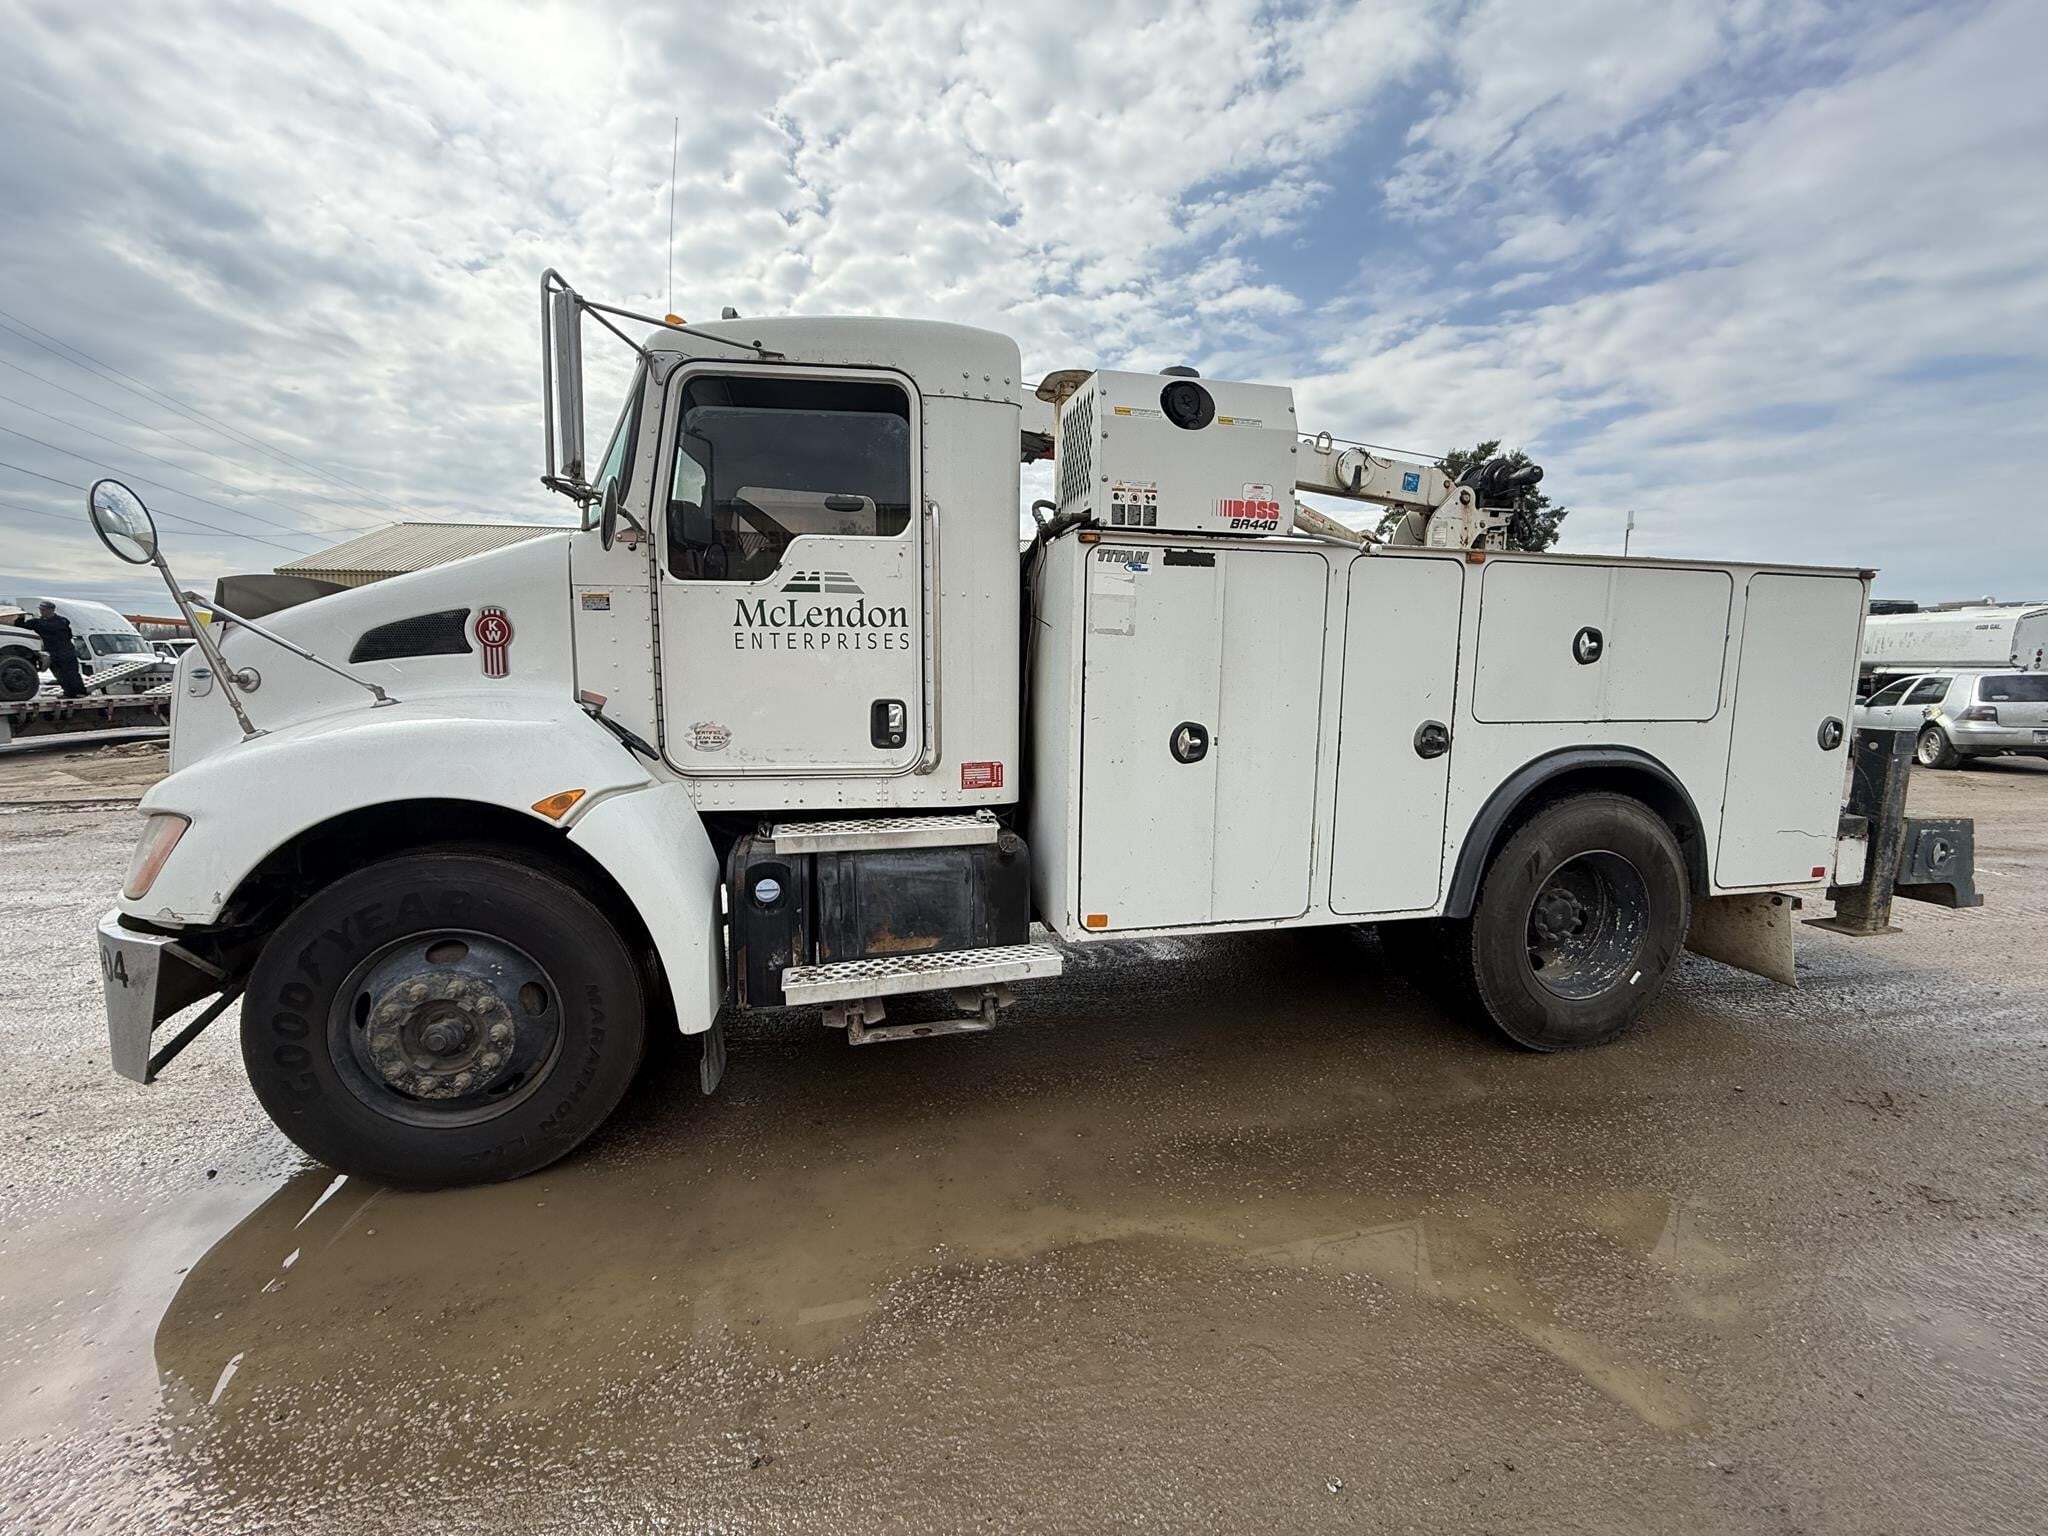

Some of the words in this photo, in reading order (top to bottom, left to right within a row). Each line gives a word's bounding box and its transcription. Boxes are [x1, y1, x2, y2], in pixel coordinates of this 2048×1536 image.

[1232, 500, 1280, 520] BOSS
[1097, 549, 1150, 564] TITAN
[733, 598, 909, 628] McLendon
[734, 632, 910, 650] ENTERPRISES
[270, 888, 474, 1106] GOODYEAR
